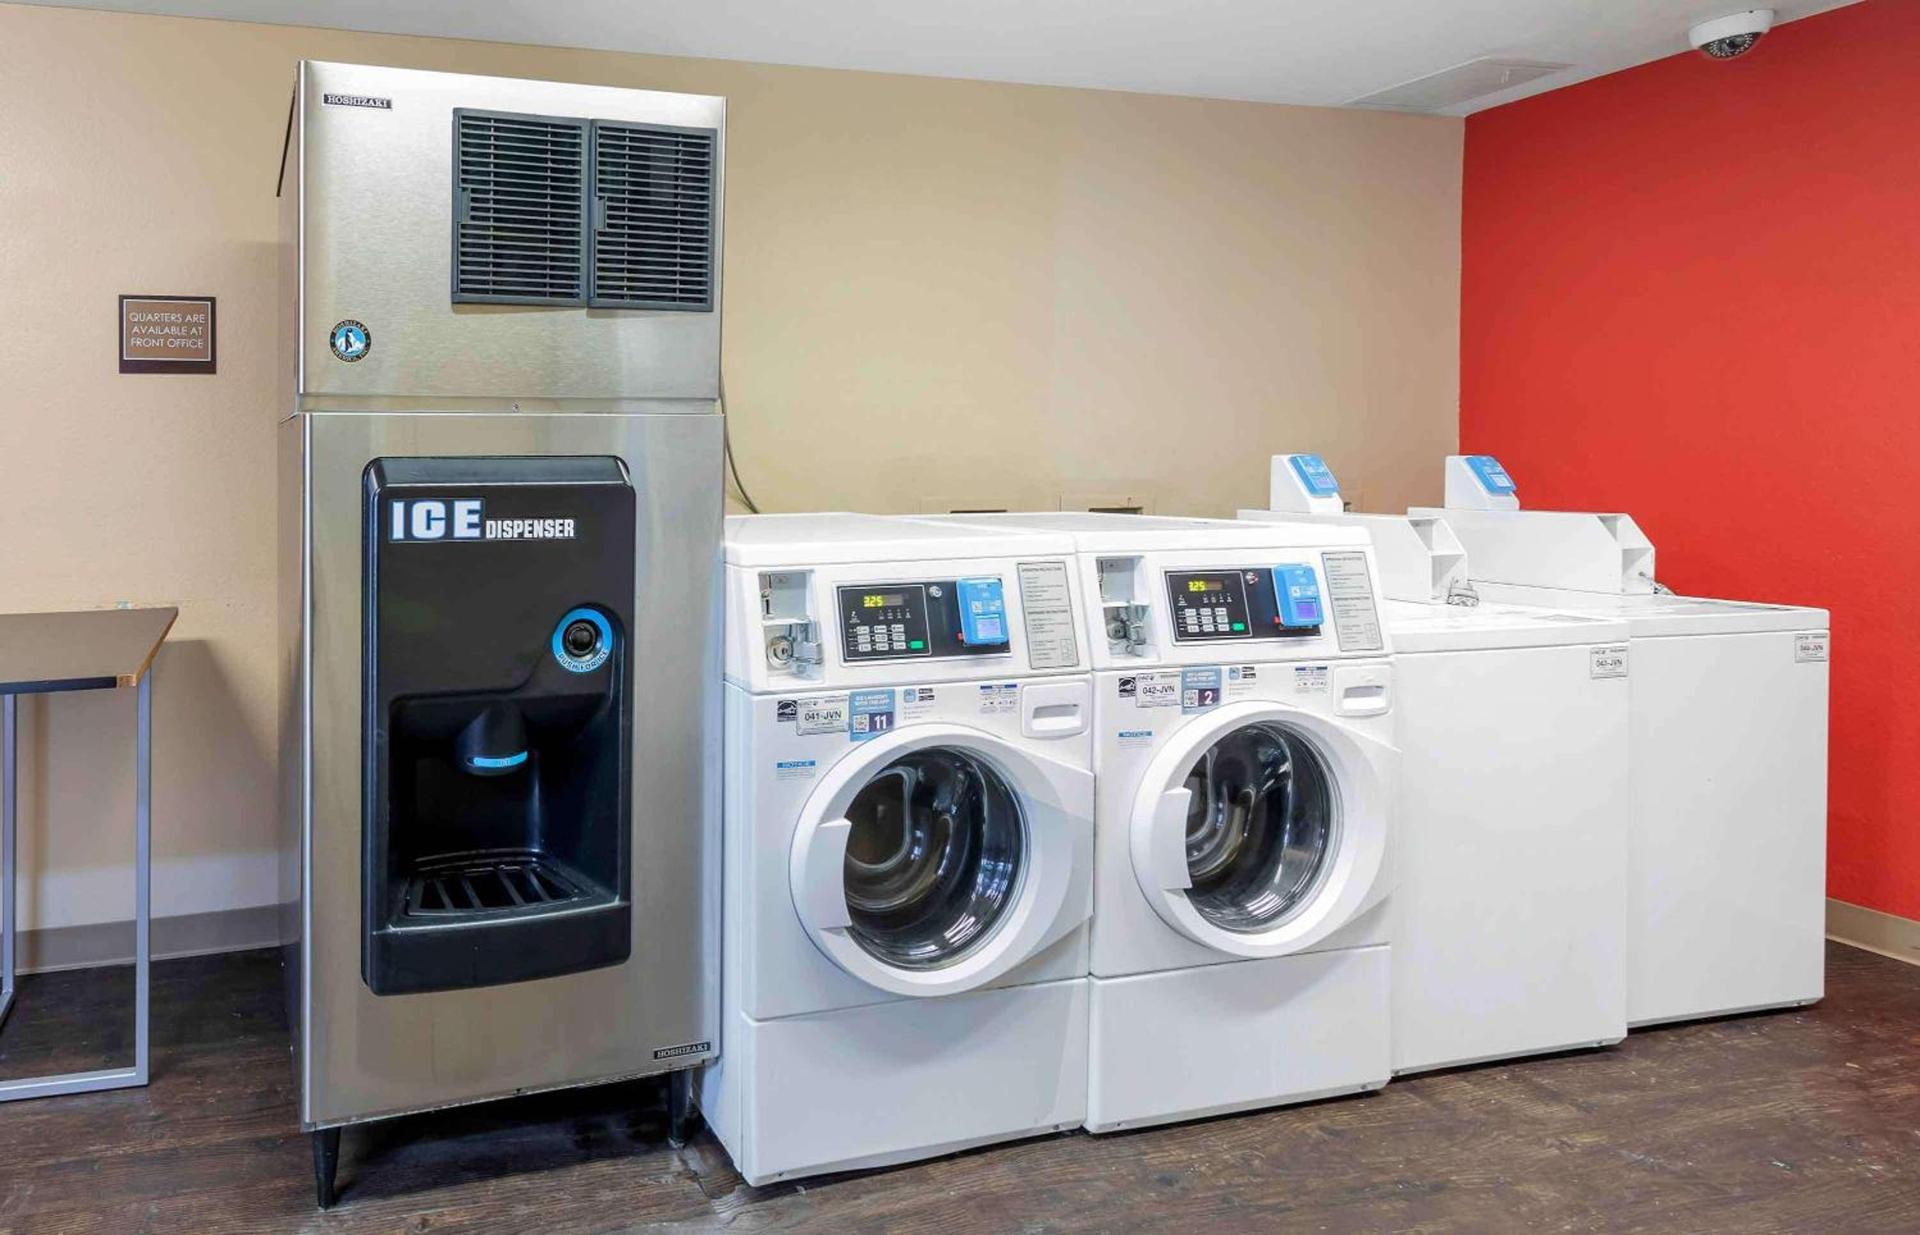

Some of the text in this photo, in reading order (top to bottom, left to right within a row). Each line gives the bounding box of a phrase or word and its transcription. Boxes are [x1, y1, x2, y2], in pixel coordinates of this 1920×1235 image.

[327, 95, 387, 108] HOSHIZAKI
[129, 312, 205, 323] QUARTERS ARE
[132, 326, 203, 336] AVAILABLE AT
[131, 337, 203, 348] FRONT OFFICE
[392, 500, 575, 539] ICE DISPENSER
[558, 652, 578, 670] PUSH
[580, 661, 597, 670] FOR
[1142, 685, 1175, 695] 042-JVN
[1204, 690, 1213, 704] 2
[804, 711, 842, 721] 041-JVN
[874, 714, 887, 729] 11
[657, 1044, 708, 1058] HOSHIZAKI
